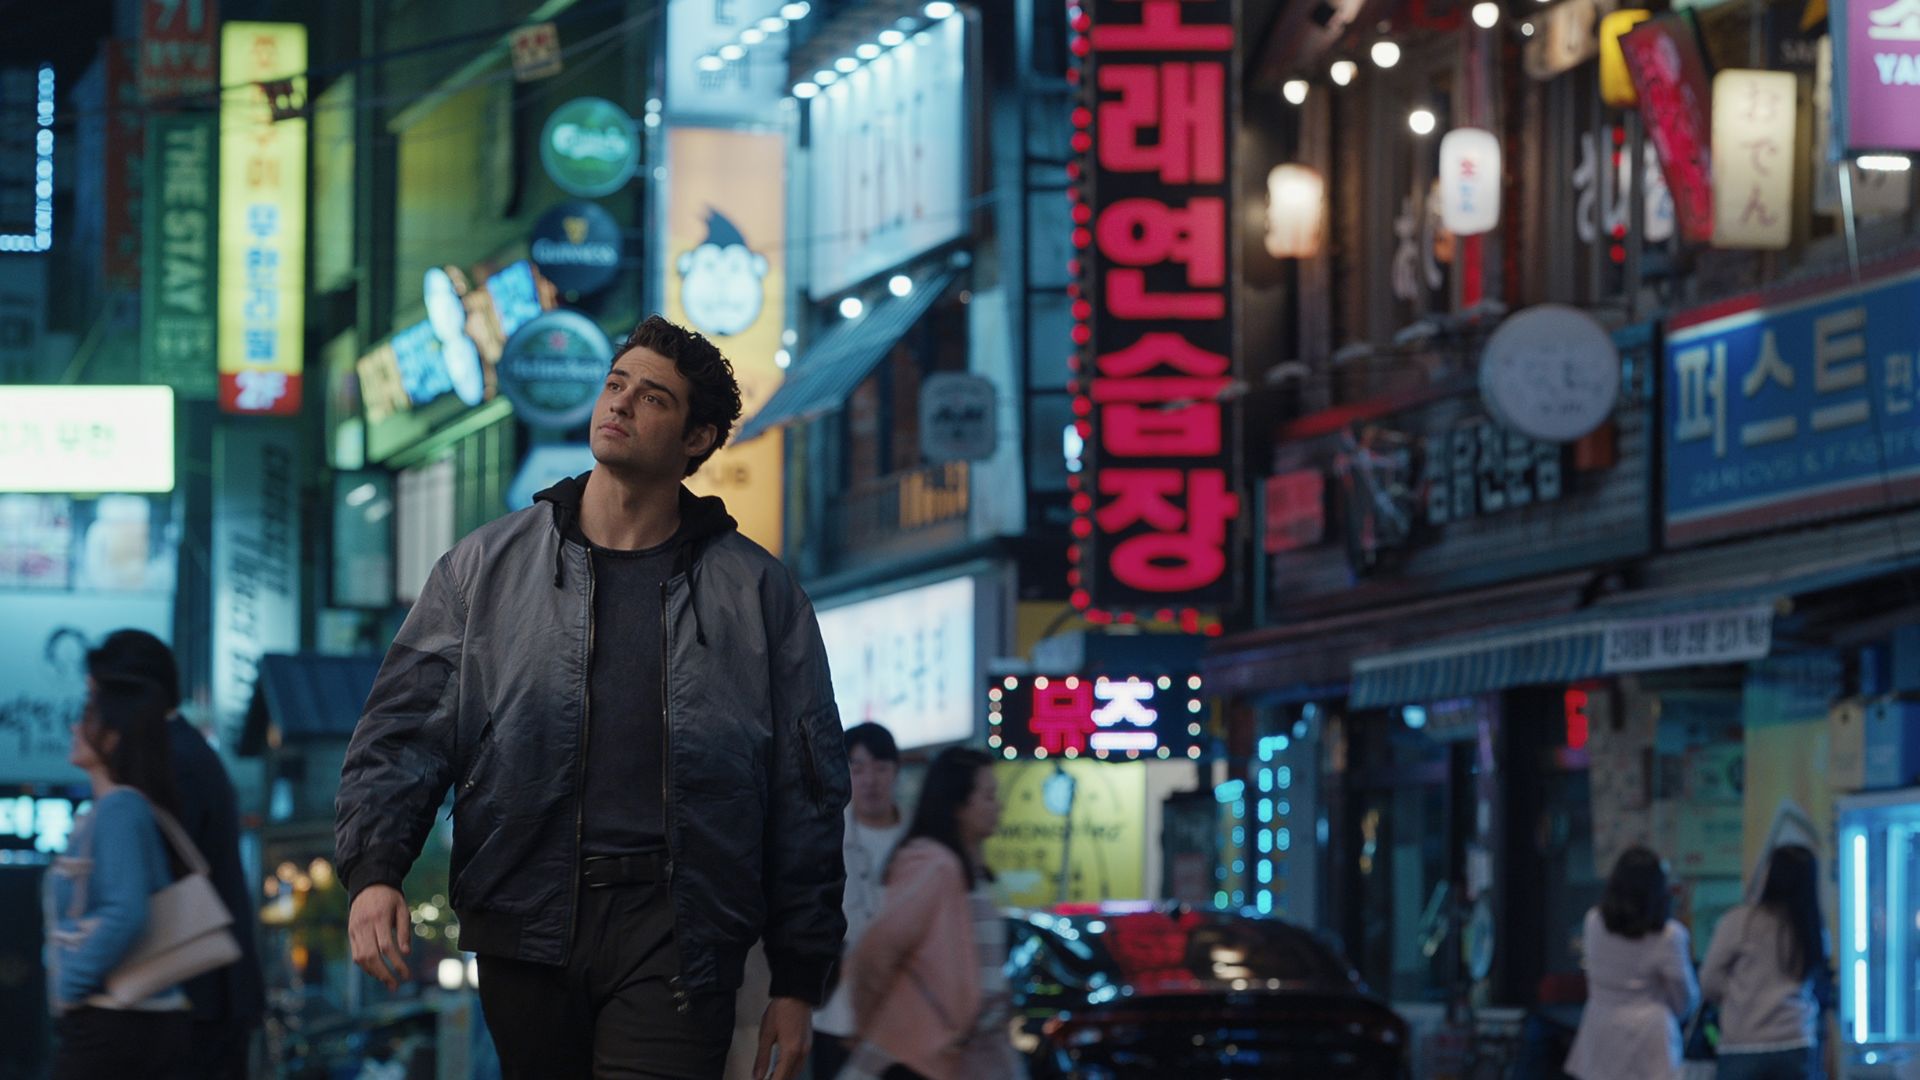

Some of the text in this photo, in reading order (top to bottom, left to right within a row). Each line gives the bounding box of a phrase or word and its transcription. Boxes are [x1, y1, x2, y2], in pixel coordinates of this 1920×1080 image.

[1873, 52, 1920, 86] YA
[164, 127, 208, 205] THE
[1738, 78, 1782, 228] おでん
[163, 209, 206, 313] STAY
[234, 371, 288, 410] 2F
[1674, 305, 1871, 458] 퍼스트
[1885, 352, 1920, 416] 편
[1029, 681, 1158, 754] 뮤즈
